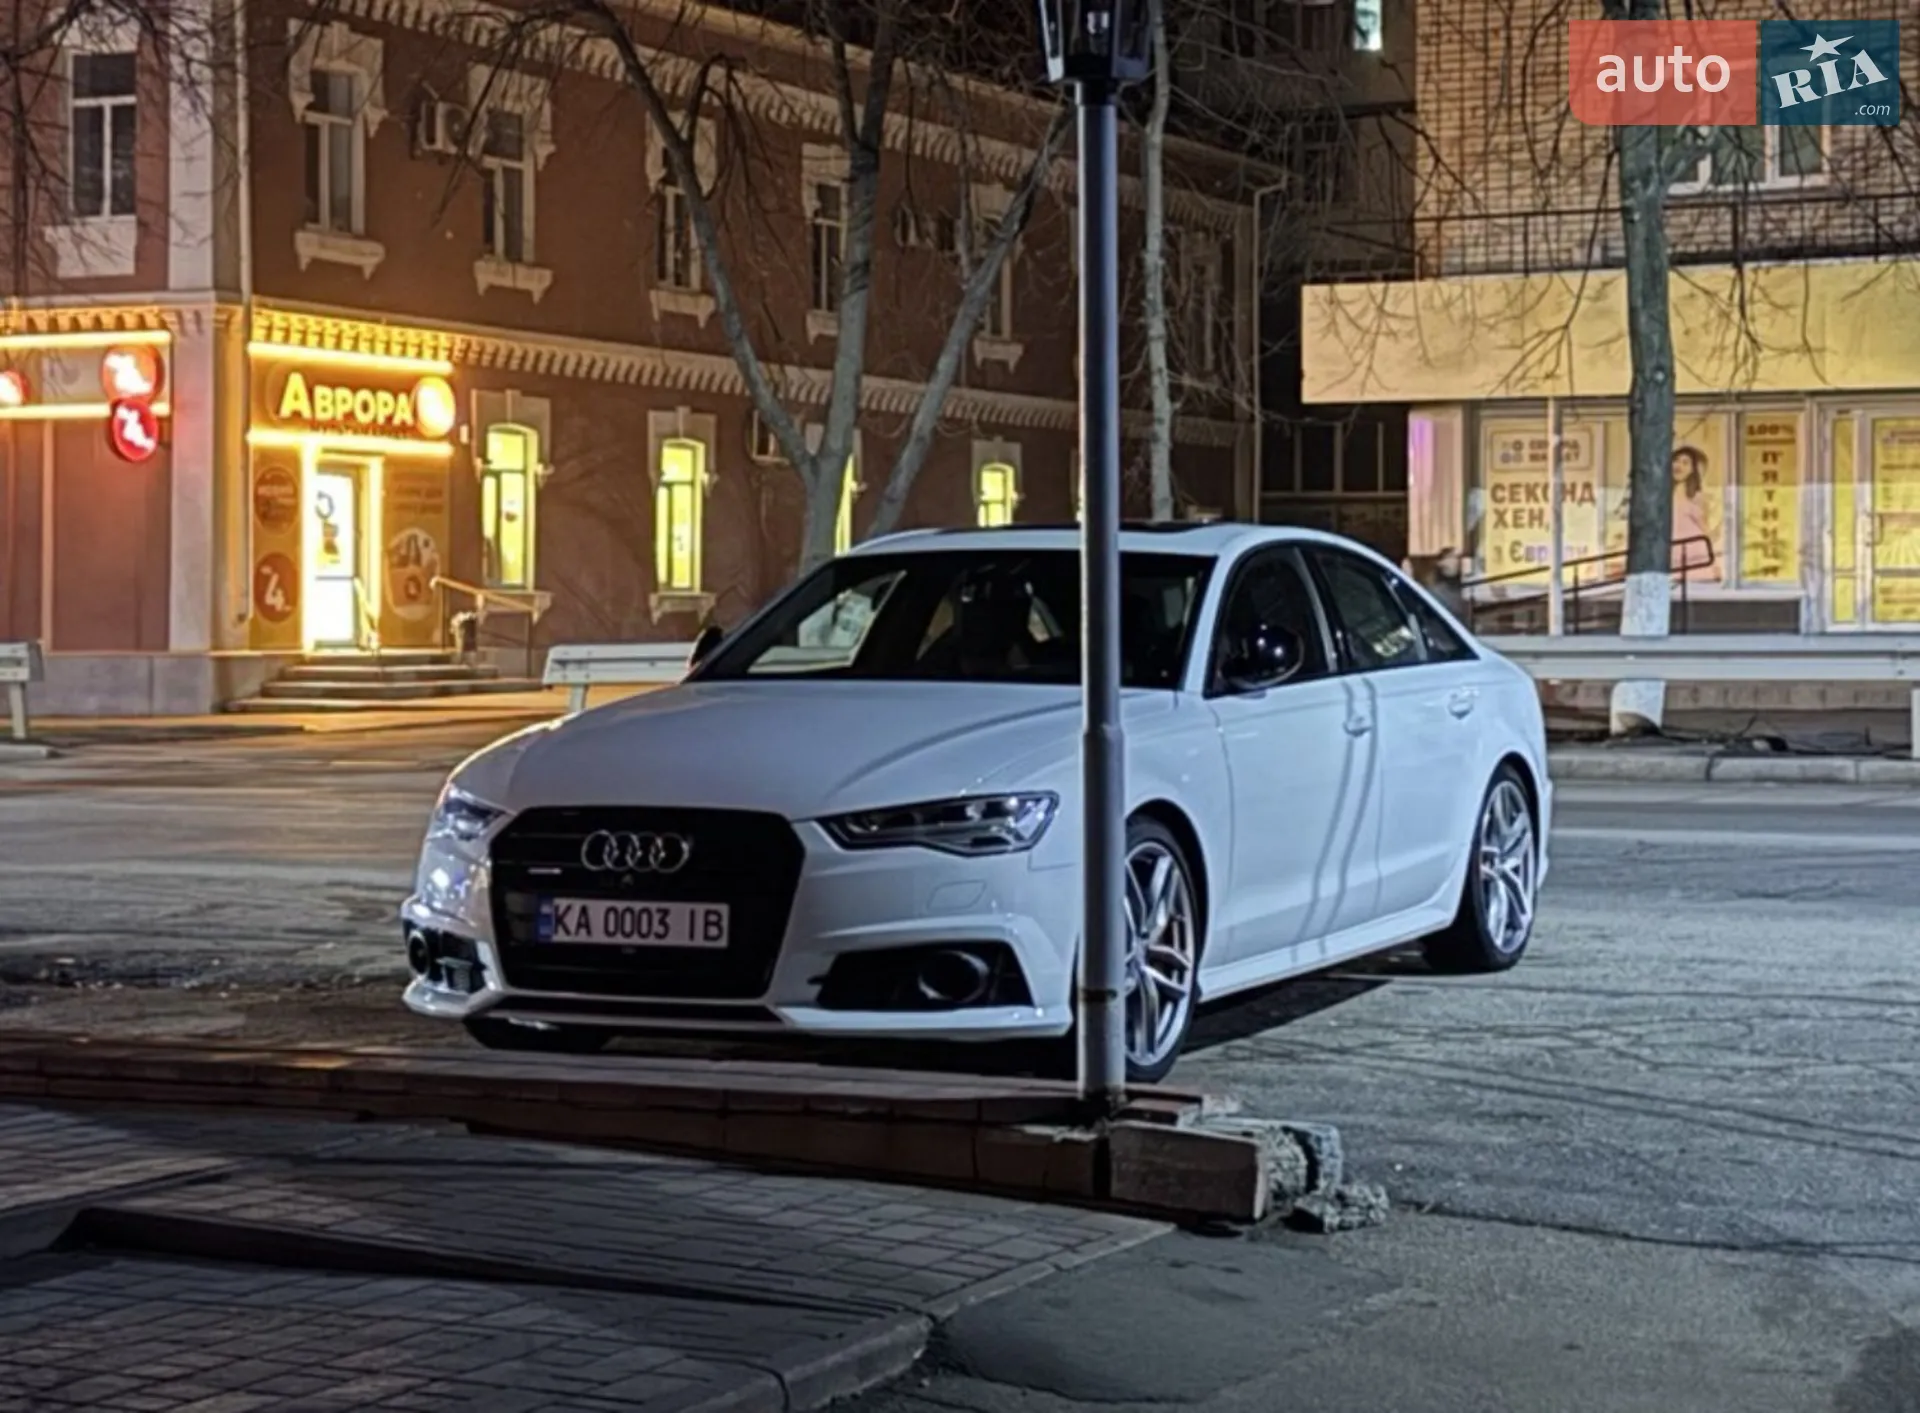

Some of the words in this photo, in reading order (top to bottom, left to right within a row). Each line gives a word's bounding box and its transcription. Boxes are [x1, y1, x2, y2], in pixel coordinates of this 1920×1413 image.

[1747, 424, 1796, 436] 100%
[1492, 508, 1551, 532] ХЕН
[554, 904, 592, 937] KA
[603, 906, 670, 940] 0003
[689, 909, 724, 942] IB
